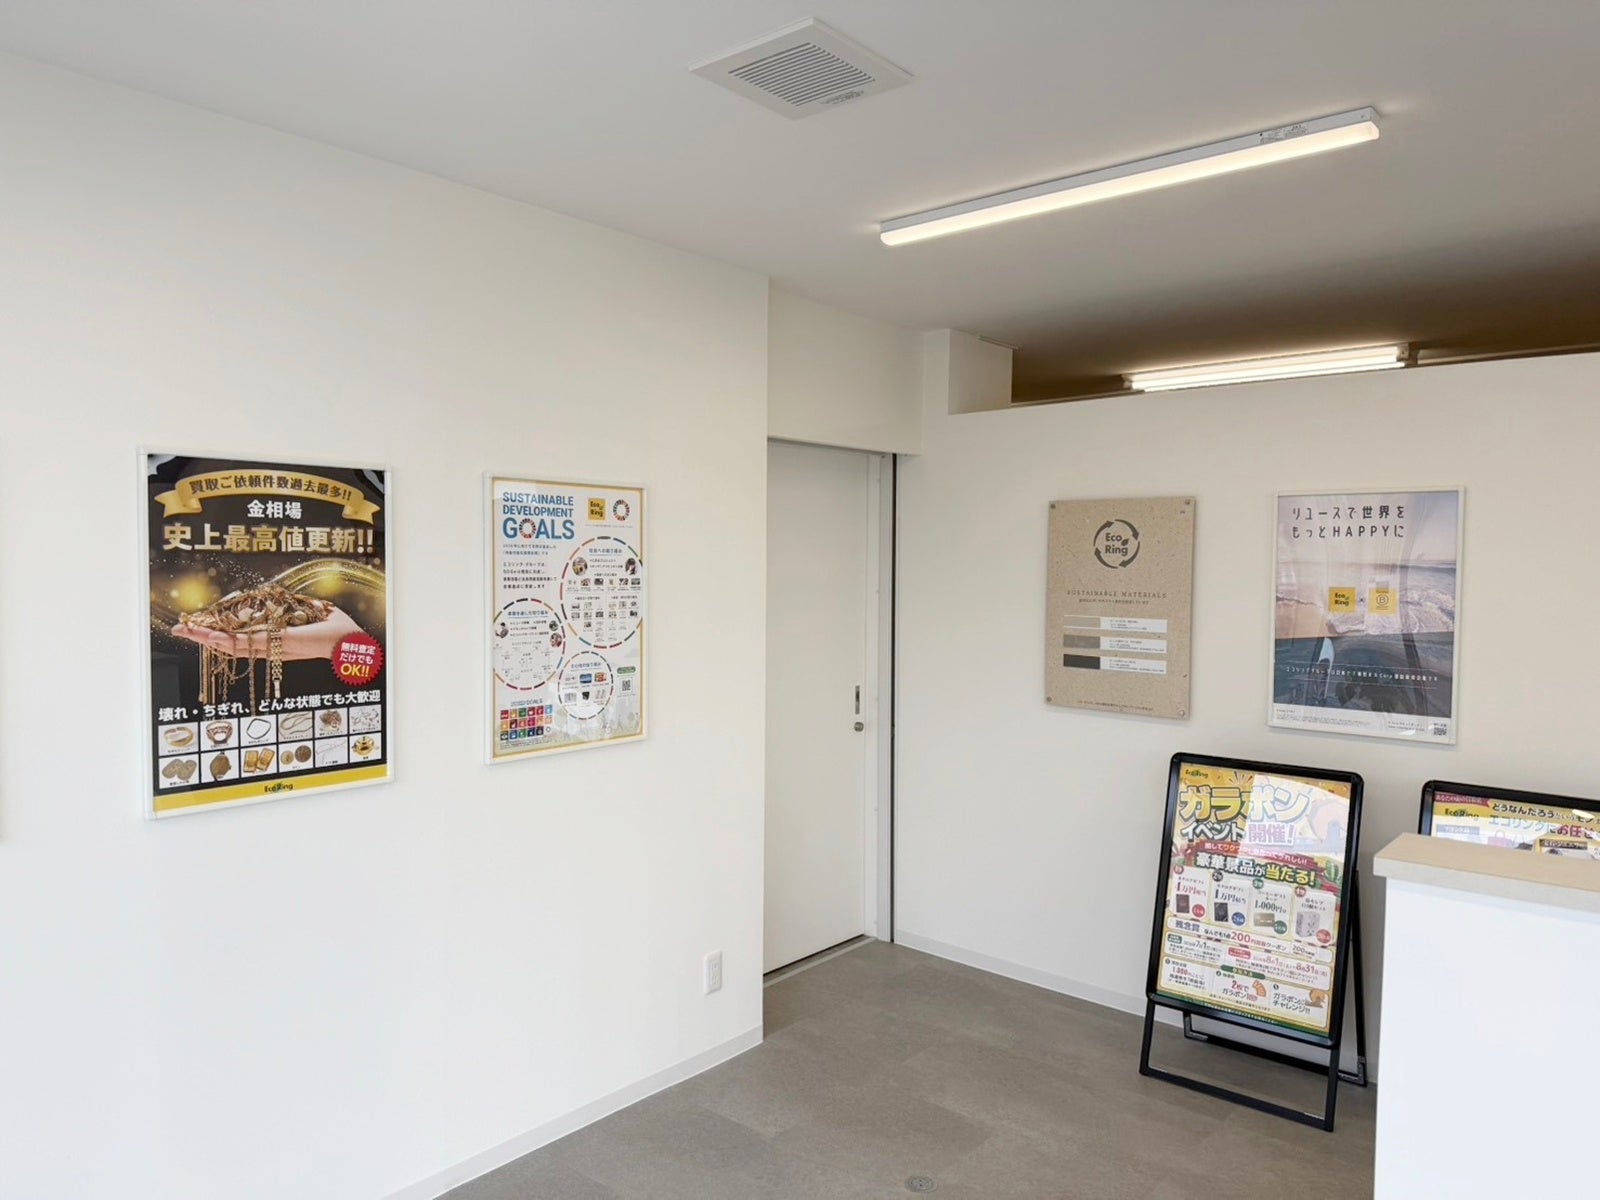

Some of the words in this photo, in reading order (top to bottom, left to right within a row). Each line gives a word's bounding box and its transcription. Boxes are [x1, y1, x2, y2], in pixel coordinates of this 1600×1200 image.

[189, 474, 352, 501] 買取ご依頼件数過去最多!!
[503, 491, 574, 506] SUSTAINABLE
[247, 499, 303, 519] 金相場
[503, 505, 574, 517] DEVELOPMENT
[1293, 505, 1405, 520] リユースで世界を
[163, 522, 374, 554] 史上最高値更新!!
[1105, 532, 1122, 542] Eco
[1293, 525, 1405, 539] もっとHAPPYに
[1105, 544, 1128, 556] Ring
[341, 642, 376, 655] 無料査定
[339, 653, 374, 665] だけでも
[341, 663, 370, 677] OK!!
[1179, 784, 1311, 824] ガラポン
